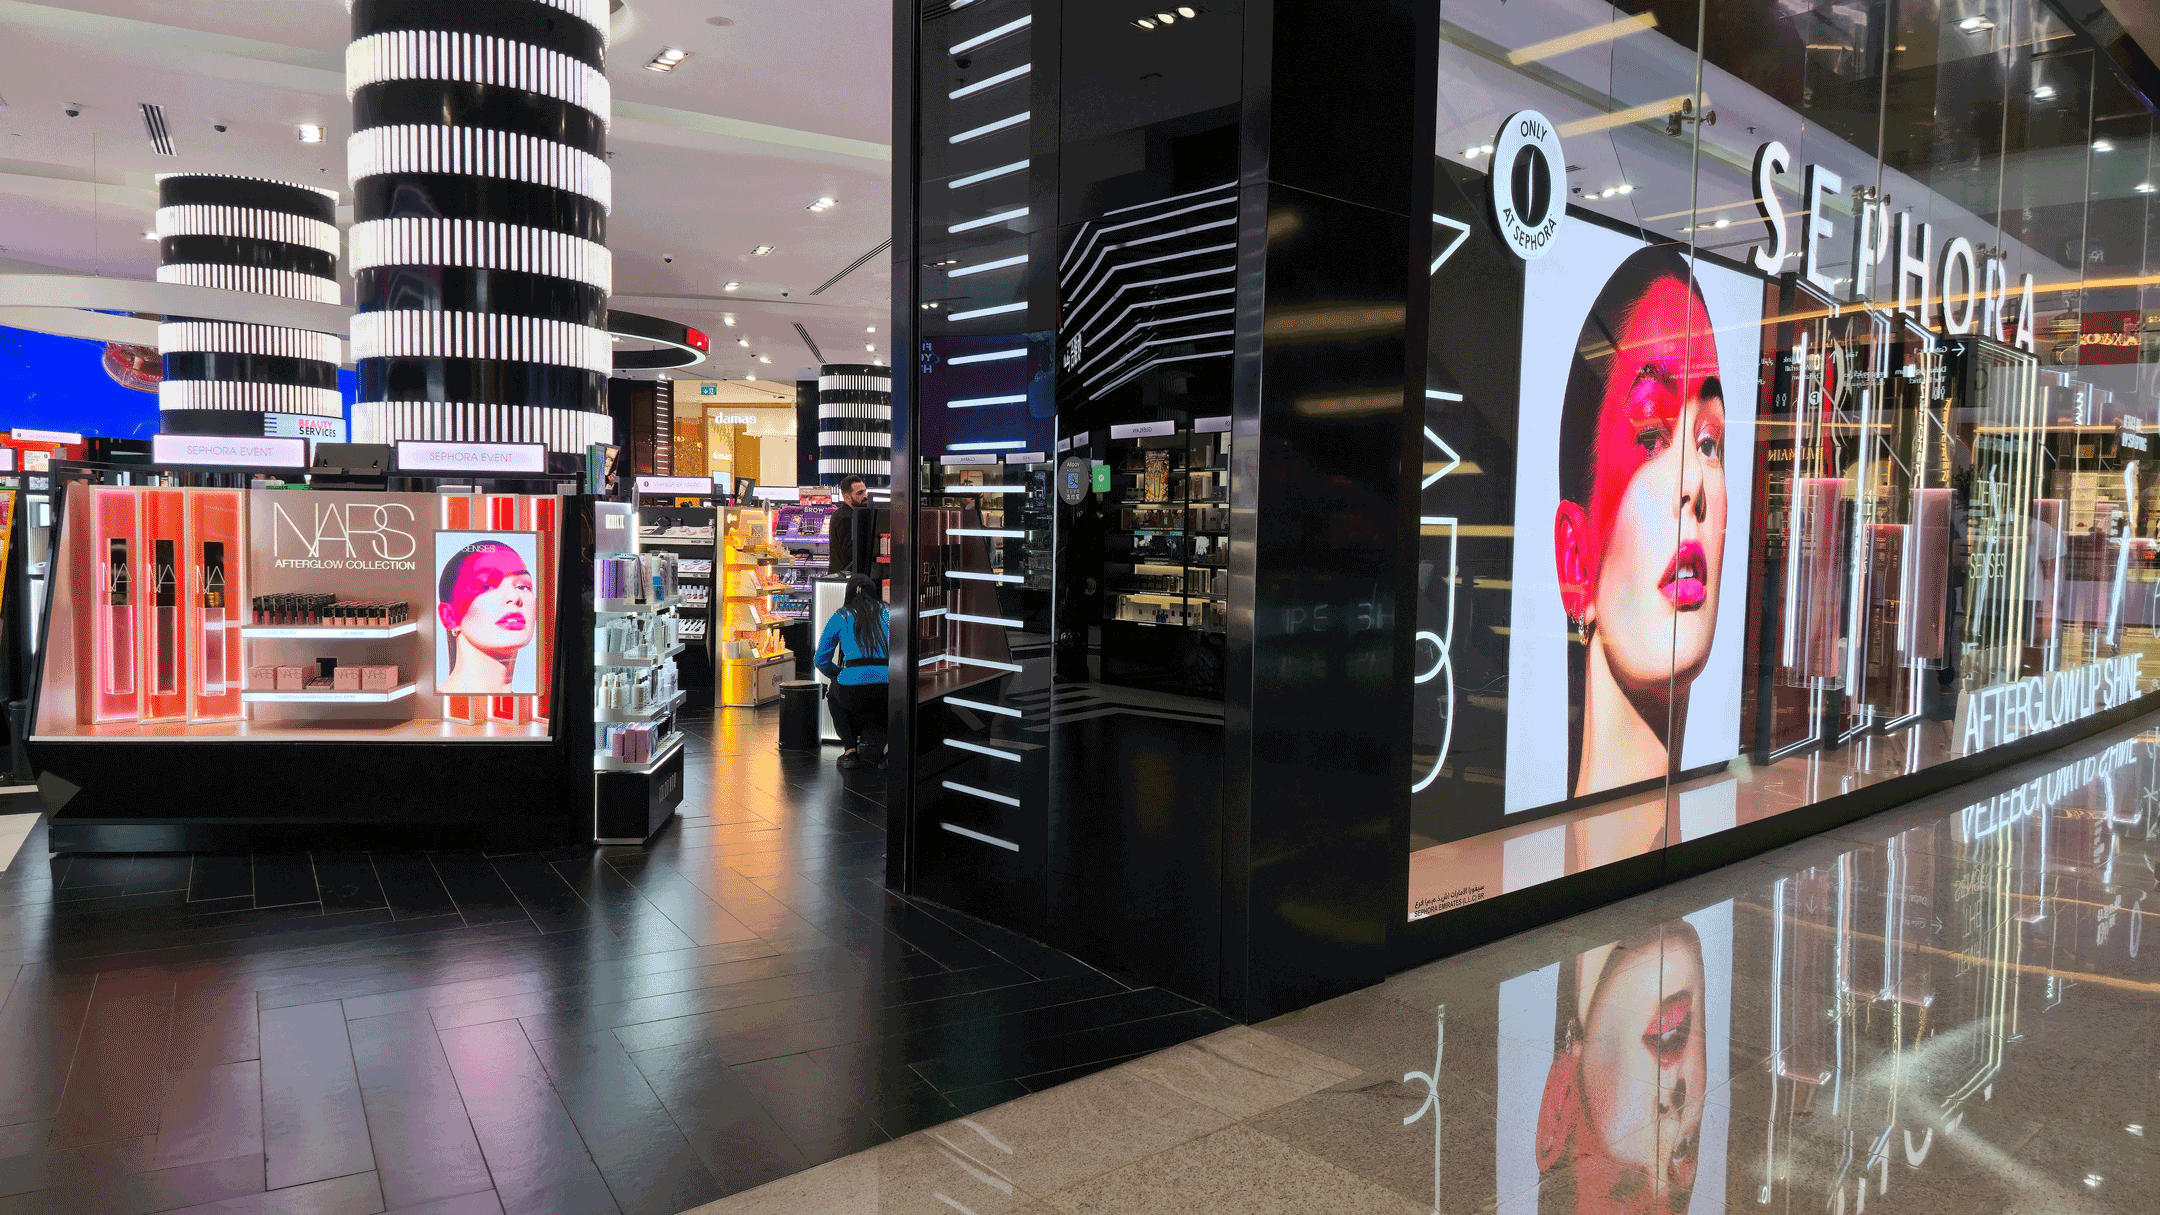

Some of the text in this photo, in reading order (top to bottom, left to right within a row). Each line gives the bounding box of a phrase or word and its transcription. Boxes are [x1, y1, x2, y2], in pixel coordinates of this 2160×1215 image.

[1520, 120, 1547, 142] ONLY
[1503, 208, 1557, 250] AT SEPHORA
[1752, 141, 2034, 353] SEPHORA
[298, 419, 332, 429] BEAUTY
[715, 411, 756, 424] damas
[299, 427, 337, 437] SERVICES
[187, 445, 274, 457] SEPHORA EVENT
[429, 452, 512, 463] SEPHORA EVENT
[273, 502, 416, 560] NARS
[461, 544, 496, 553] SENSES
[275, 559, 416, 570] AFTERGLOW COLLECTION
[1962, 653, 2144, 758] AFTERGLOW LIP SHINE
[1414, 905, 1438, 917] SEPHORA
[1439, 899, 1462, 911] EMIRATES
